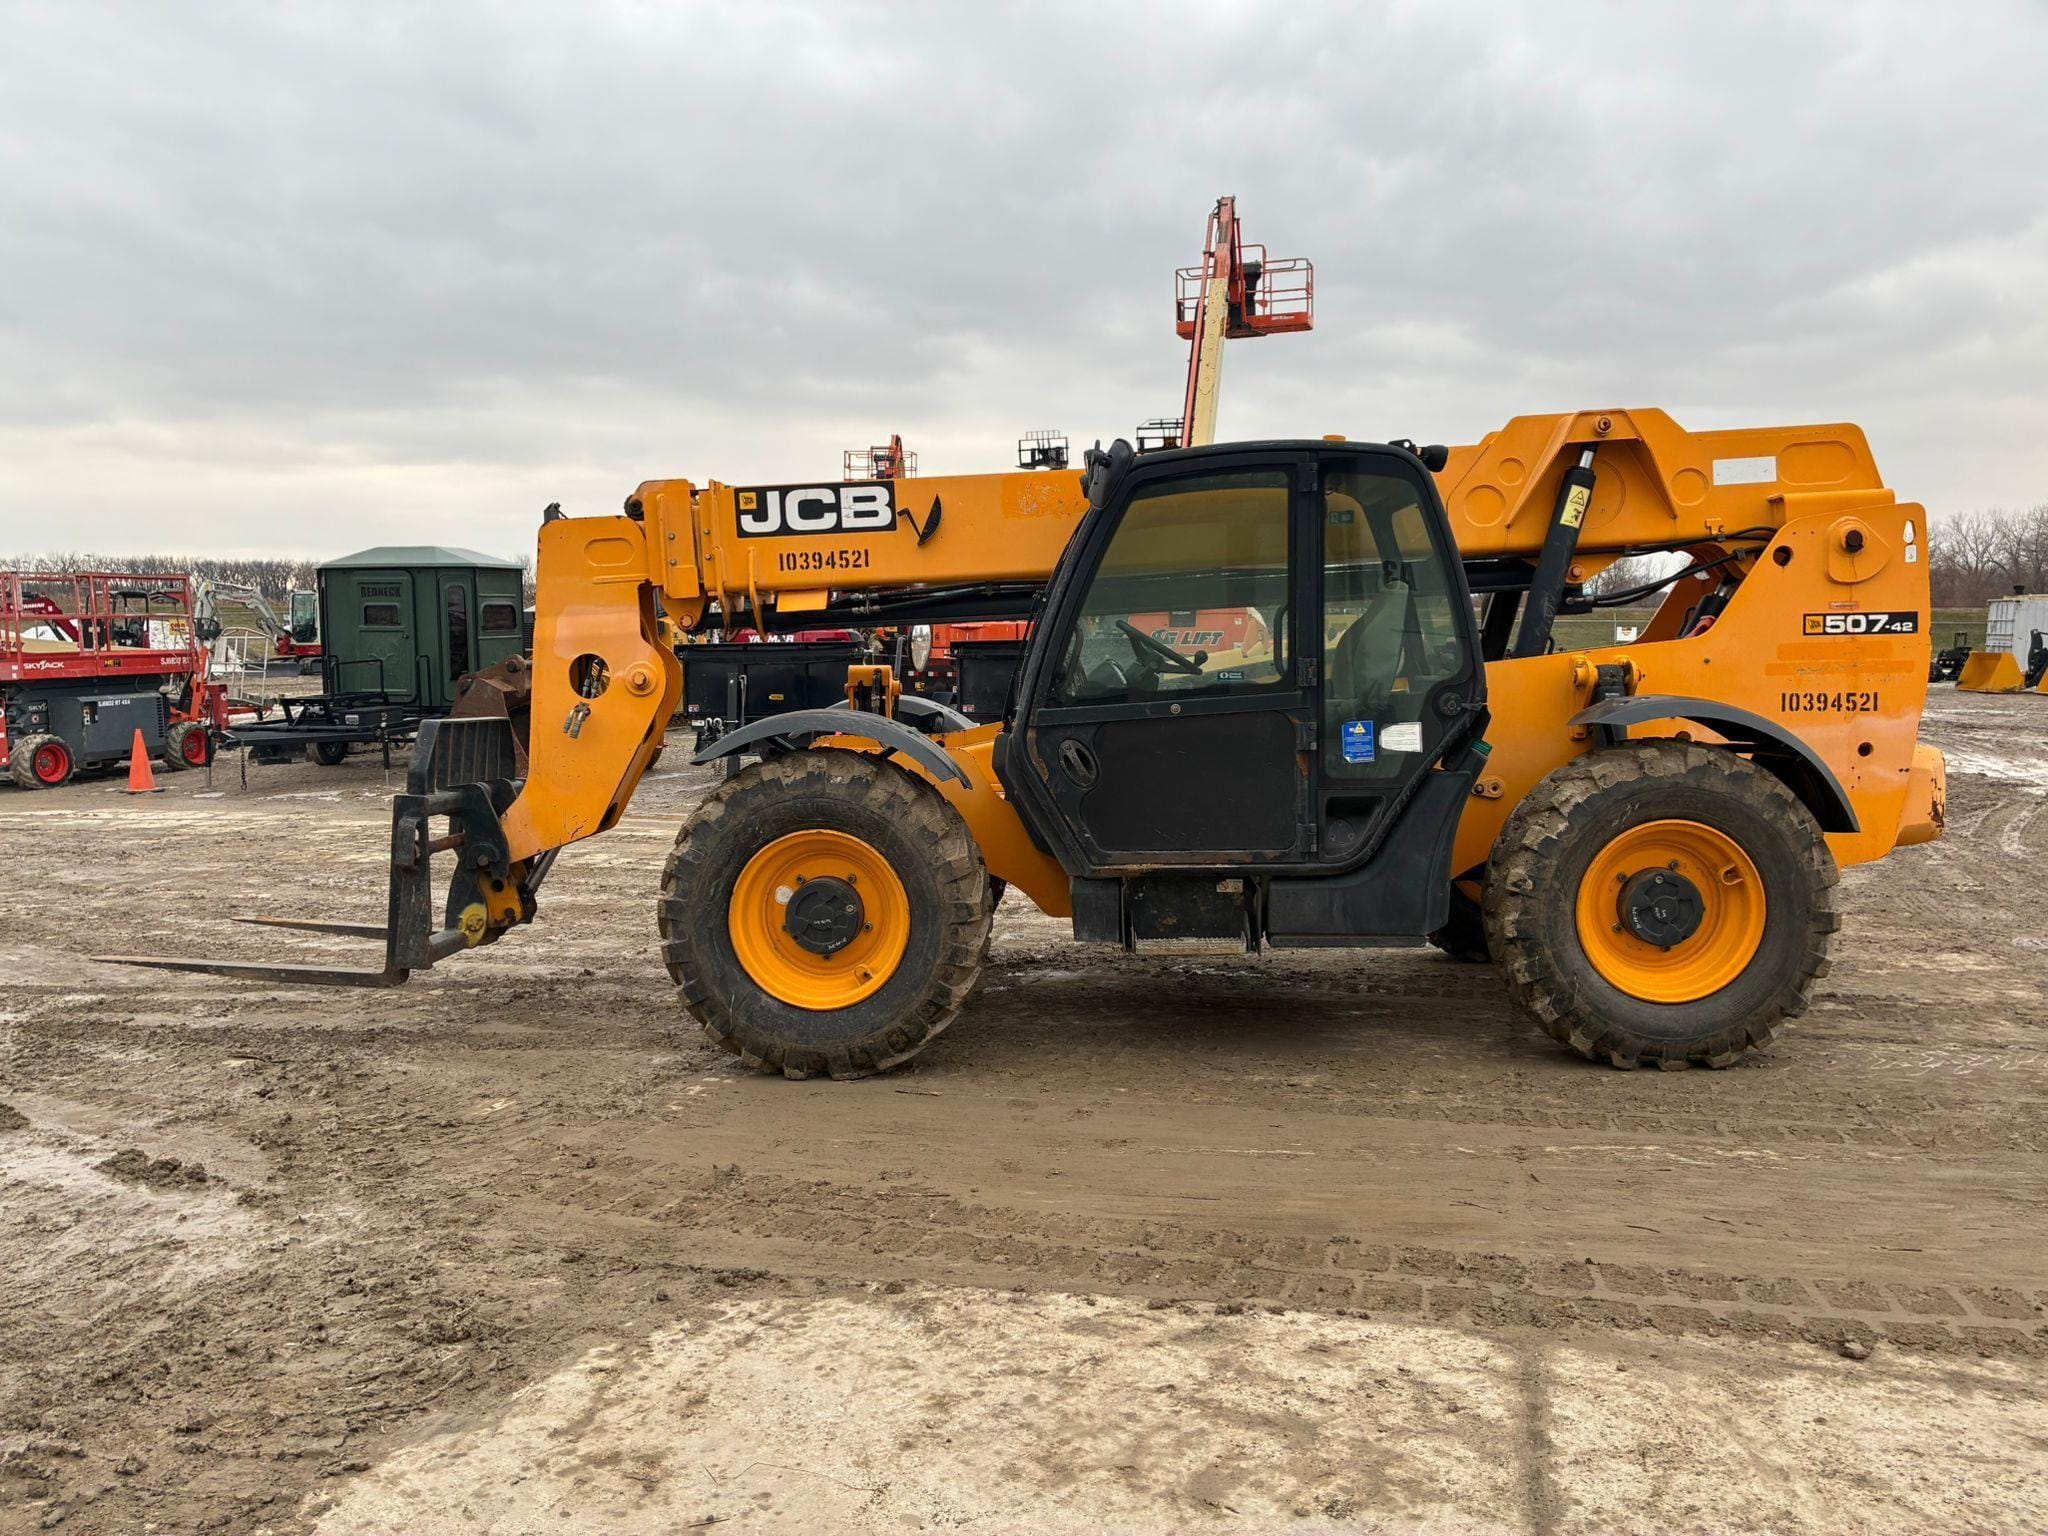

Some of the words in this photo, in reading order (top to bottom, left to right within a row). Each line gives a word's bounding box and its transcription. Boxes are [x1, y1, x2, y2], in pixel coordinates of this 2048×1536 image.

[740, 485, 892, 533] JCB
[779, 549, 869, 571] 10394521
[360, 586, 402, 598] REDNECK
[22, 602, 45, 610] ANMAR
[1825, 614, 1913, 633] 507-42
[1180, 630, 1225, 646] LIFT
[23, 660, 64, 670] SKYJACK
[1781, 692, 1878, 712] 10394521
